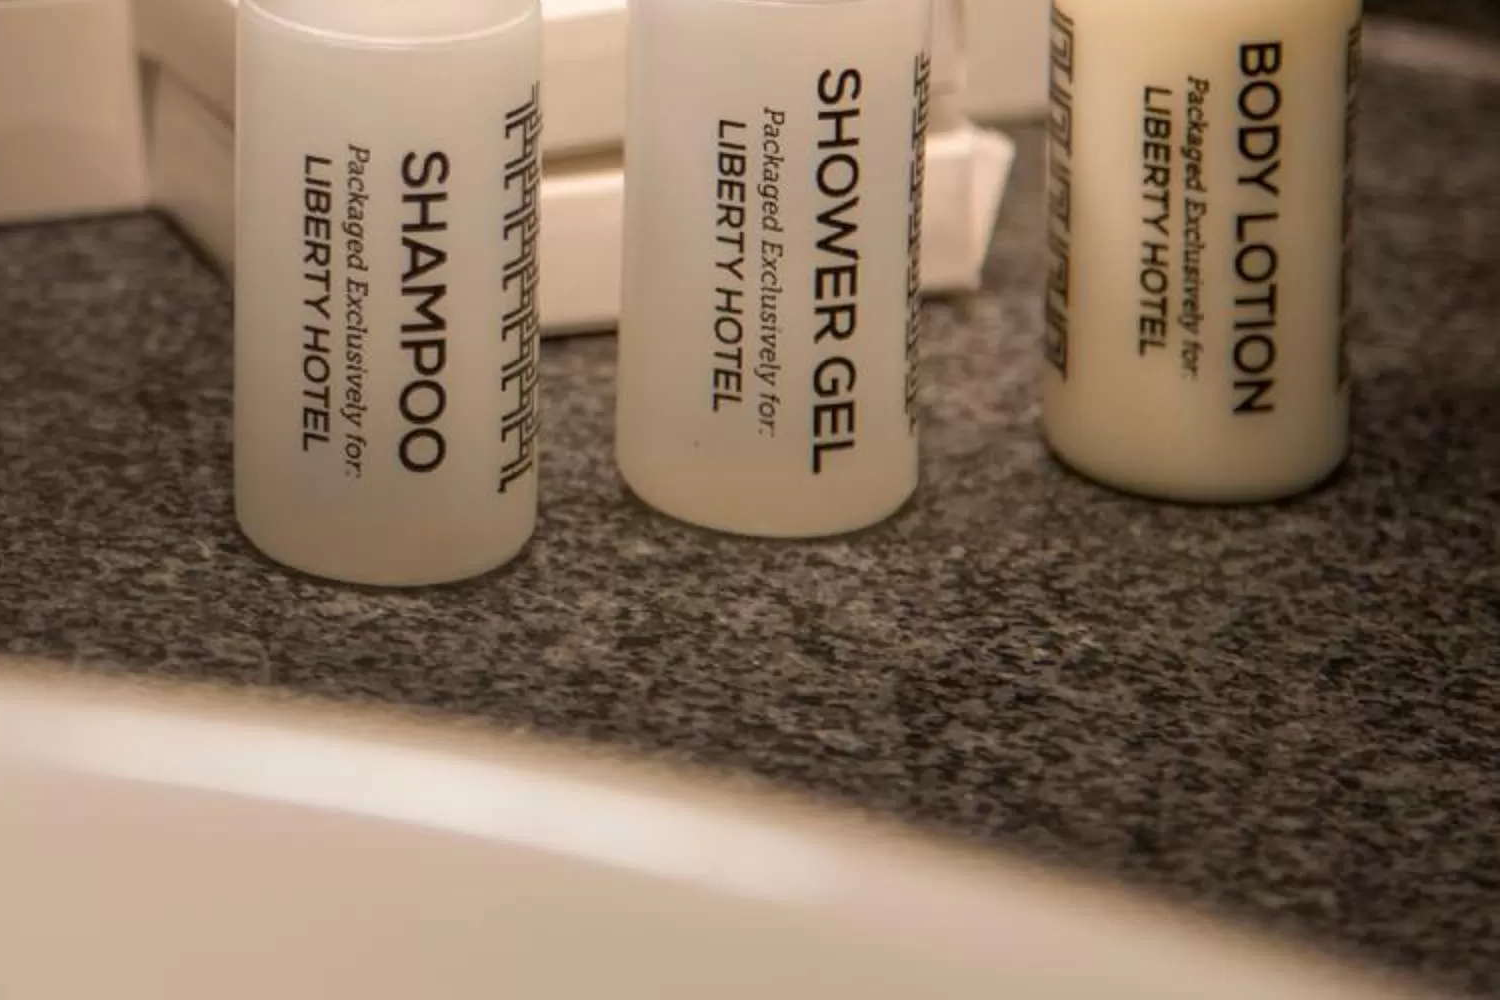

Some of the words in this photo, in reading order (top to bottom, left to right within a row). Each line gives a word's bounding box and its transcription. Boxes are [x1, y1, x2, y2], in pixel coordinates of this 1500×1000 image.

[756, 105, 786, 233] Packaged
[1140, 84, 1173, 238] LIBERTY
[1180, 74, 1210, 193] Packaged
[1236, 40, 1283, 197] BODY
[302, 153, 333, 321] LIBERTY
[340, 143, 371, 273] Packaged
[714, 119, 747, 282] LIBERTY
[812, 67, 863, 345] SHOWER
[1178, 197, 1208, 335] Exclusively
[339, 276, 370, 429] Exclusively
[397, 150, 451, 474] SHAMPOO
[712, 286, 745, 413] HOTEL
[753, 239, 785, 387] Exclusively
[1137, 239, 1169, 357] HOTEL
[1231, 212, 1280, 417] LOTION
[301, 323, 332, 453] HOTEL
[811, 355, 858, 476] GEL
